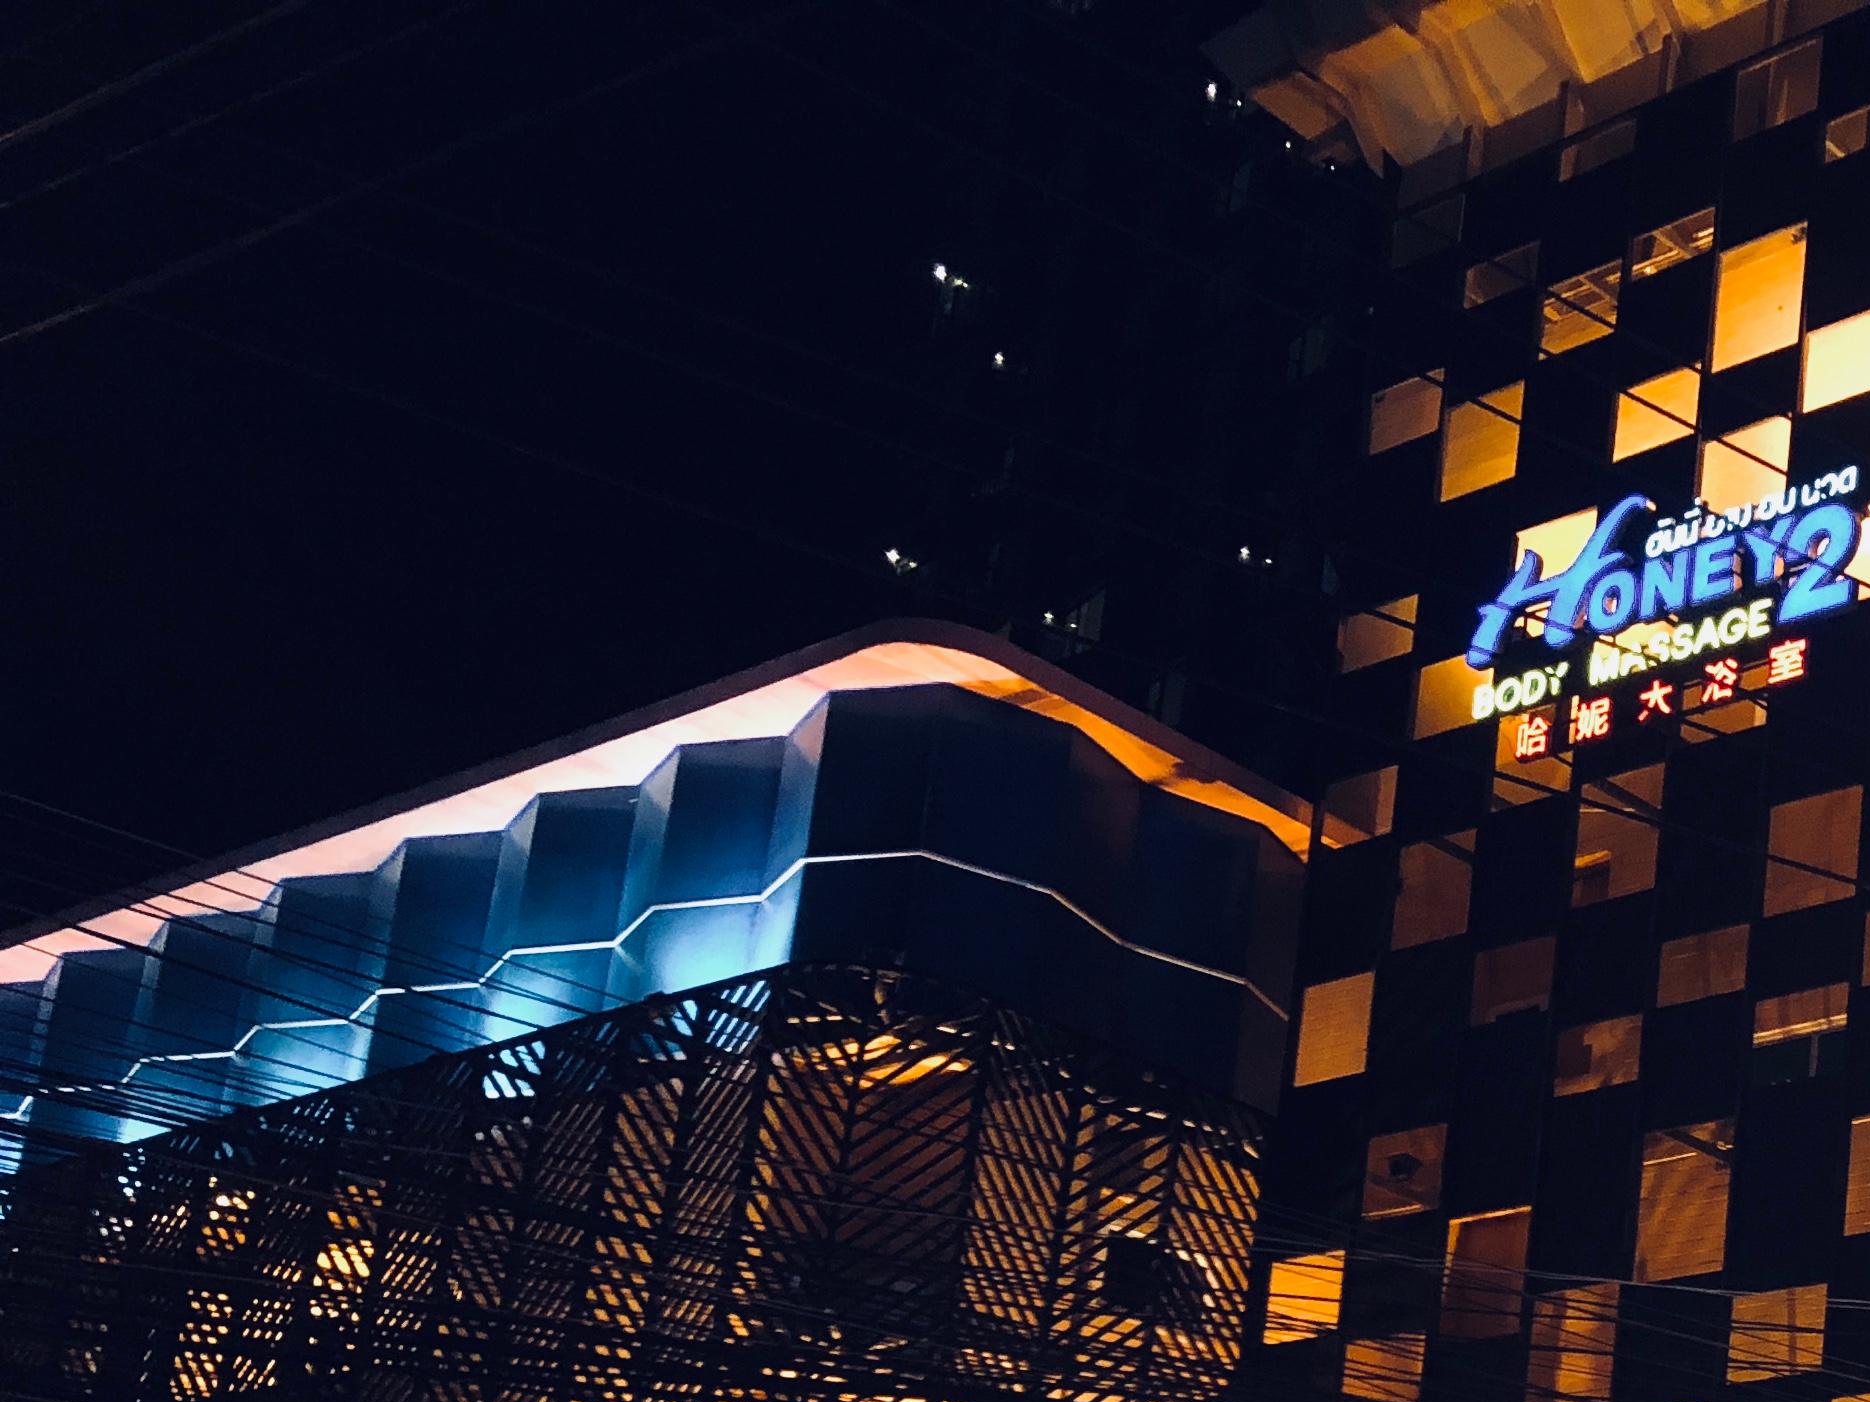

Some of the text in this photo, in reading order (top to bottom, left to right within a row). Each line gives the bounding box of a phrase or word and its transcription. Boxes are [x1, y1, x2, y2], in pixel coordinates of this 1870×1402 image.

[1471, 598, 1774, 721] BODY MASSAGE
[1514, 638, 1809, 761] 哈妮大浴室
